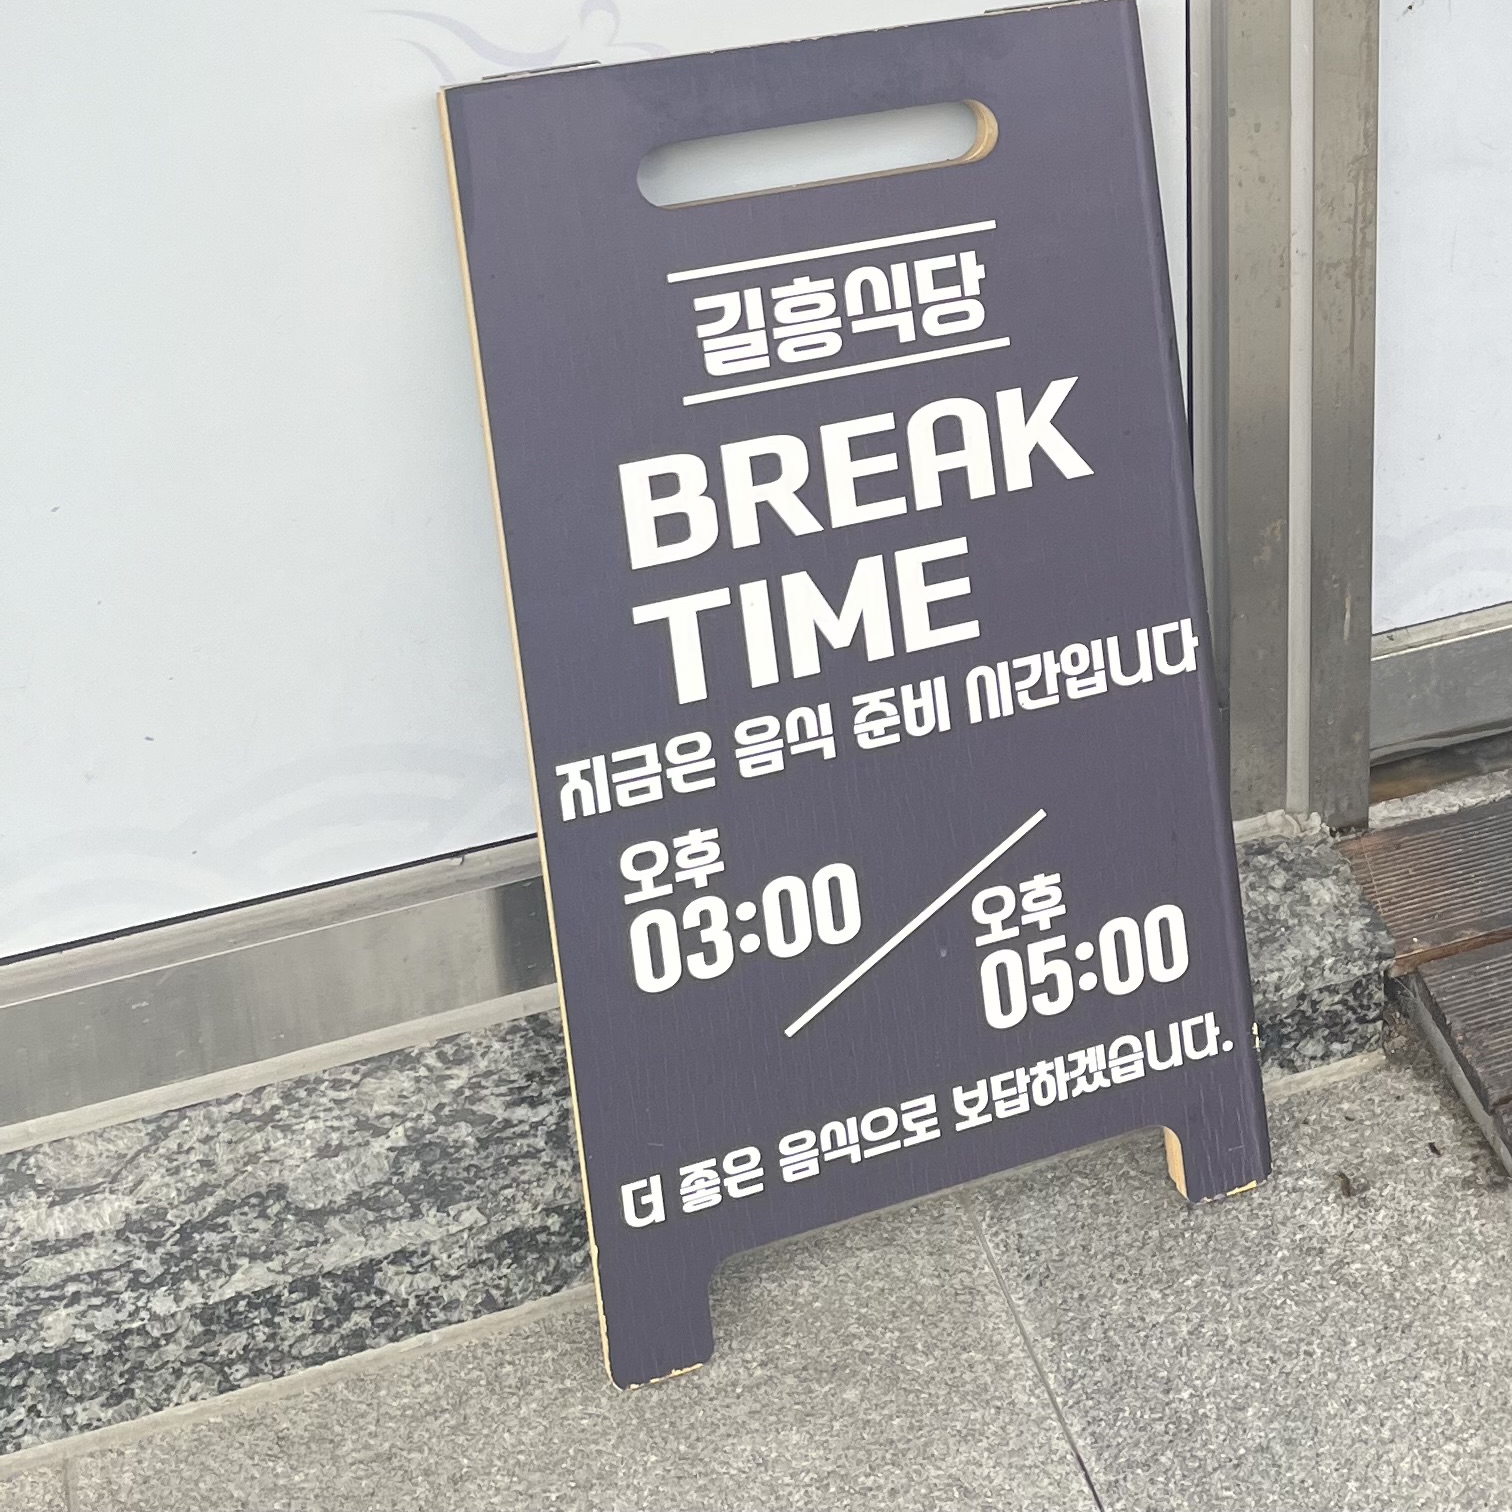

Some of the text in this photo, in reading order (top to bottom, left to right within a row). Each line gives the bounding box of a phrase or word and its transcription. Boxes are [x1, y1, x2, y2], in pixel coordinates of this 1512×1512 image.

[693, 249, 987, 378] 길흥식당
[617, 375, 1095, 571] BREAK
[632, 537, 982, 706] TIME
[555, 618, 1202, 823] 지금은 음식 준비 시간입니다
[619, 828, 725, 906] 오후
[629, 863, 864, 995] 03:00
[969, 872, 1067, 949] 오후
[979, 904, 1191, 1030] 05:00
[620, 1010, 1235, 1230] 더 좋은 음식으로 보답하겠습니다.
